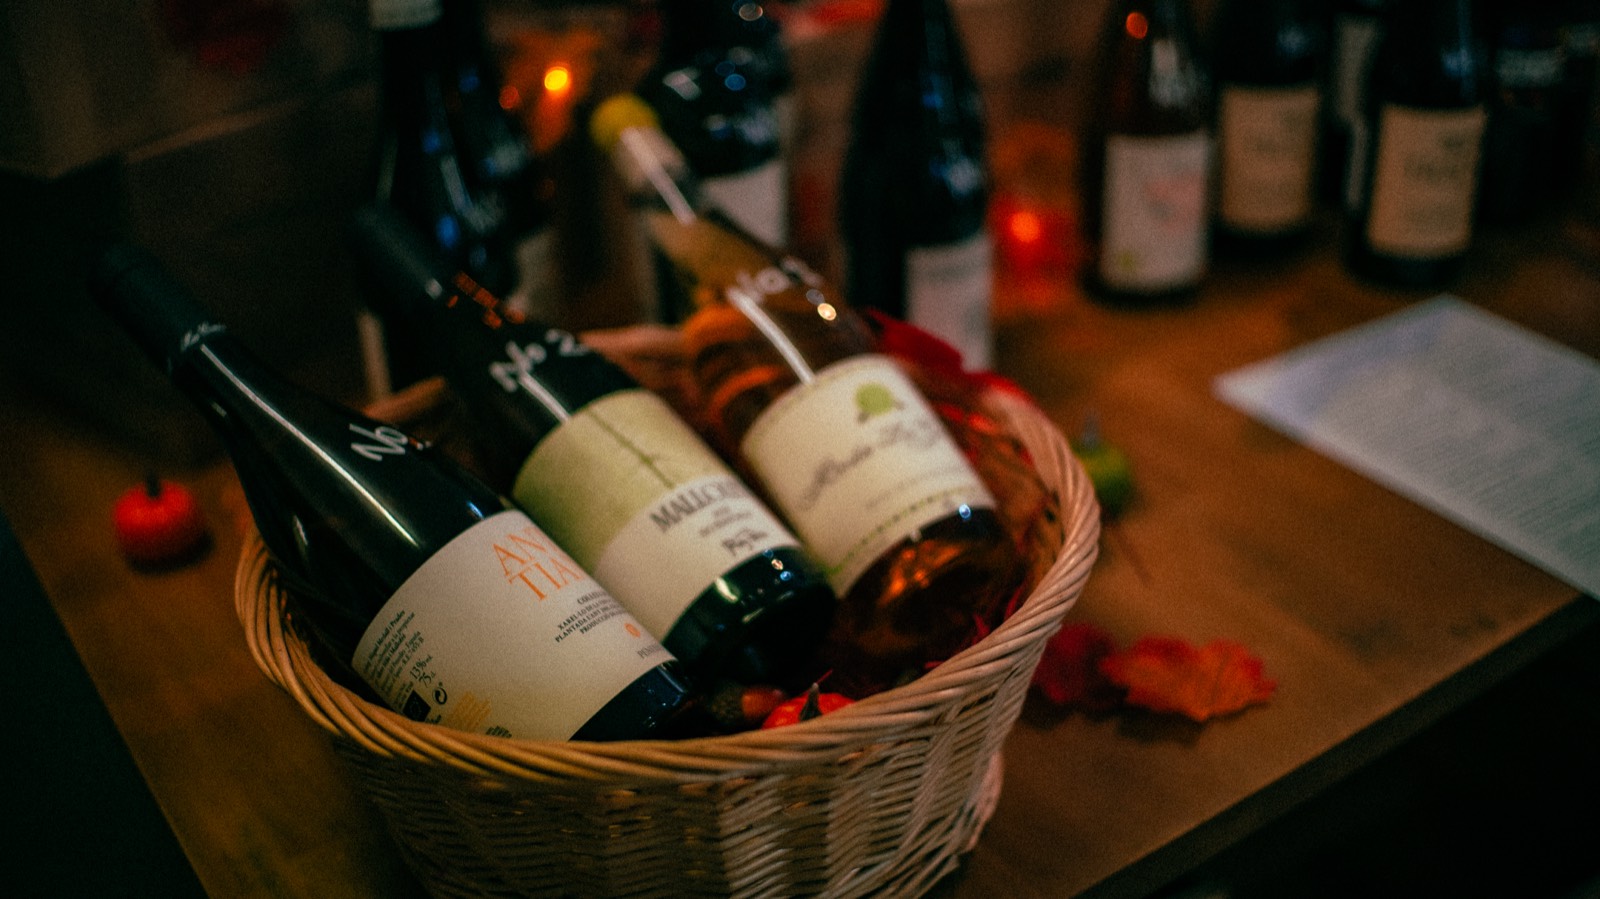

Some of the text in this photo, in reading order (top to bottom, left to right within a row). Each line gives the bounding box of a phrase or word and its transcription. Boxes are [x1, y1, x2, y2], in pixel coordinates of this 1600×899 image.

[488, 341, 547, 393] No
[348, 423, 409, 462] No
[554, 617, 588, 643] PLANTADA
